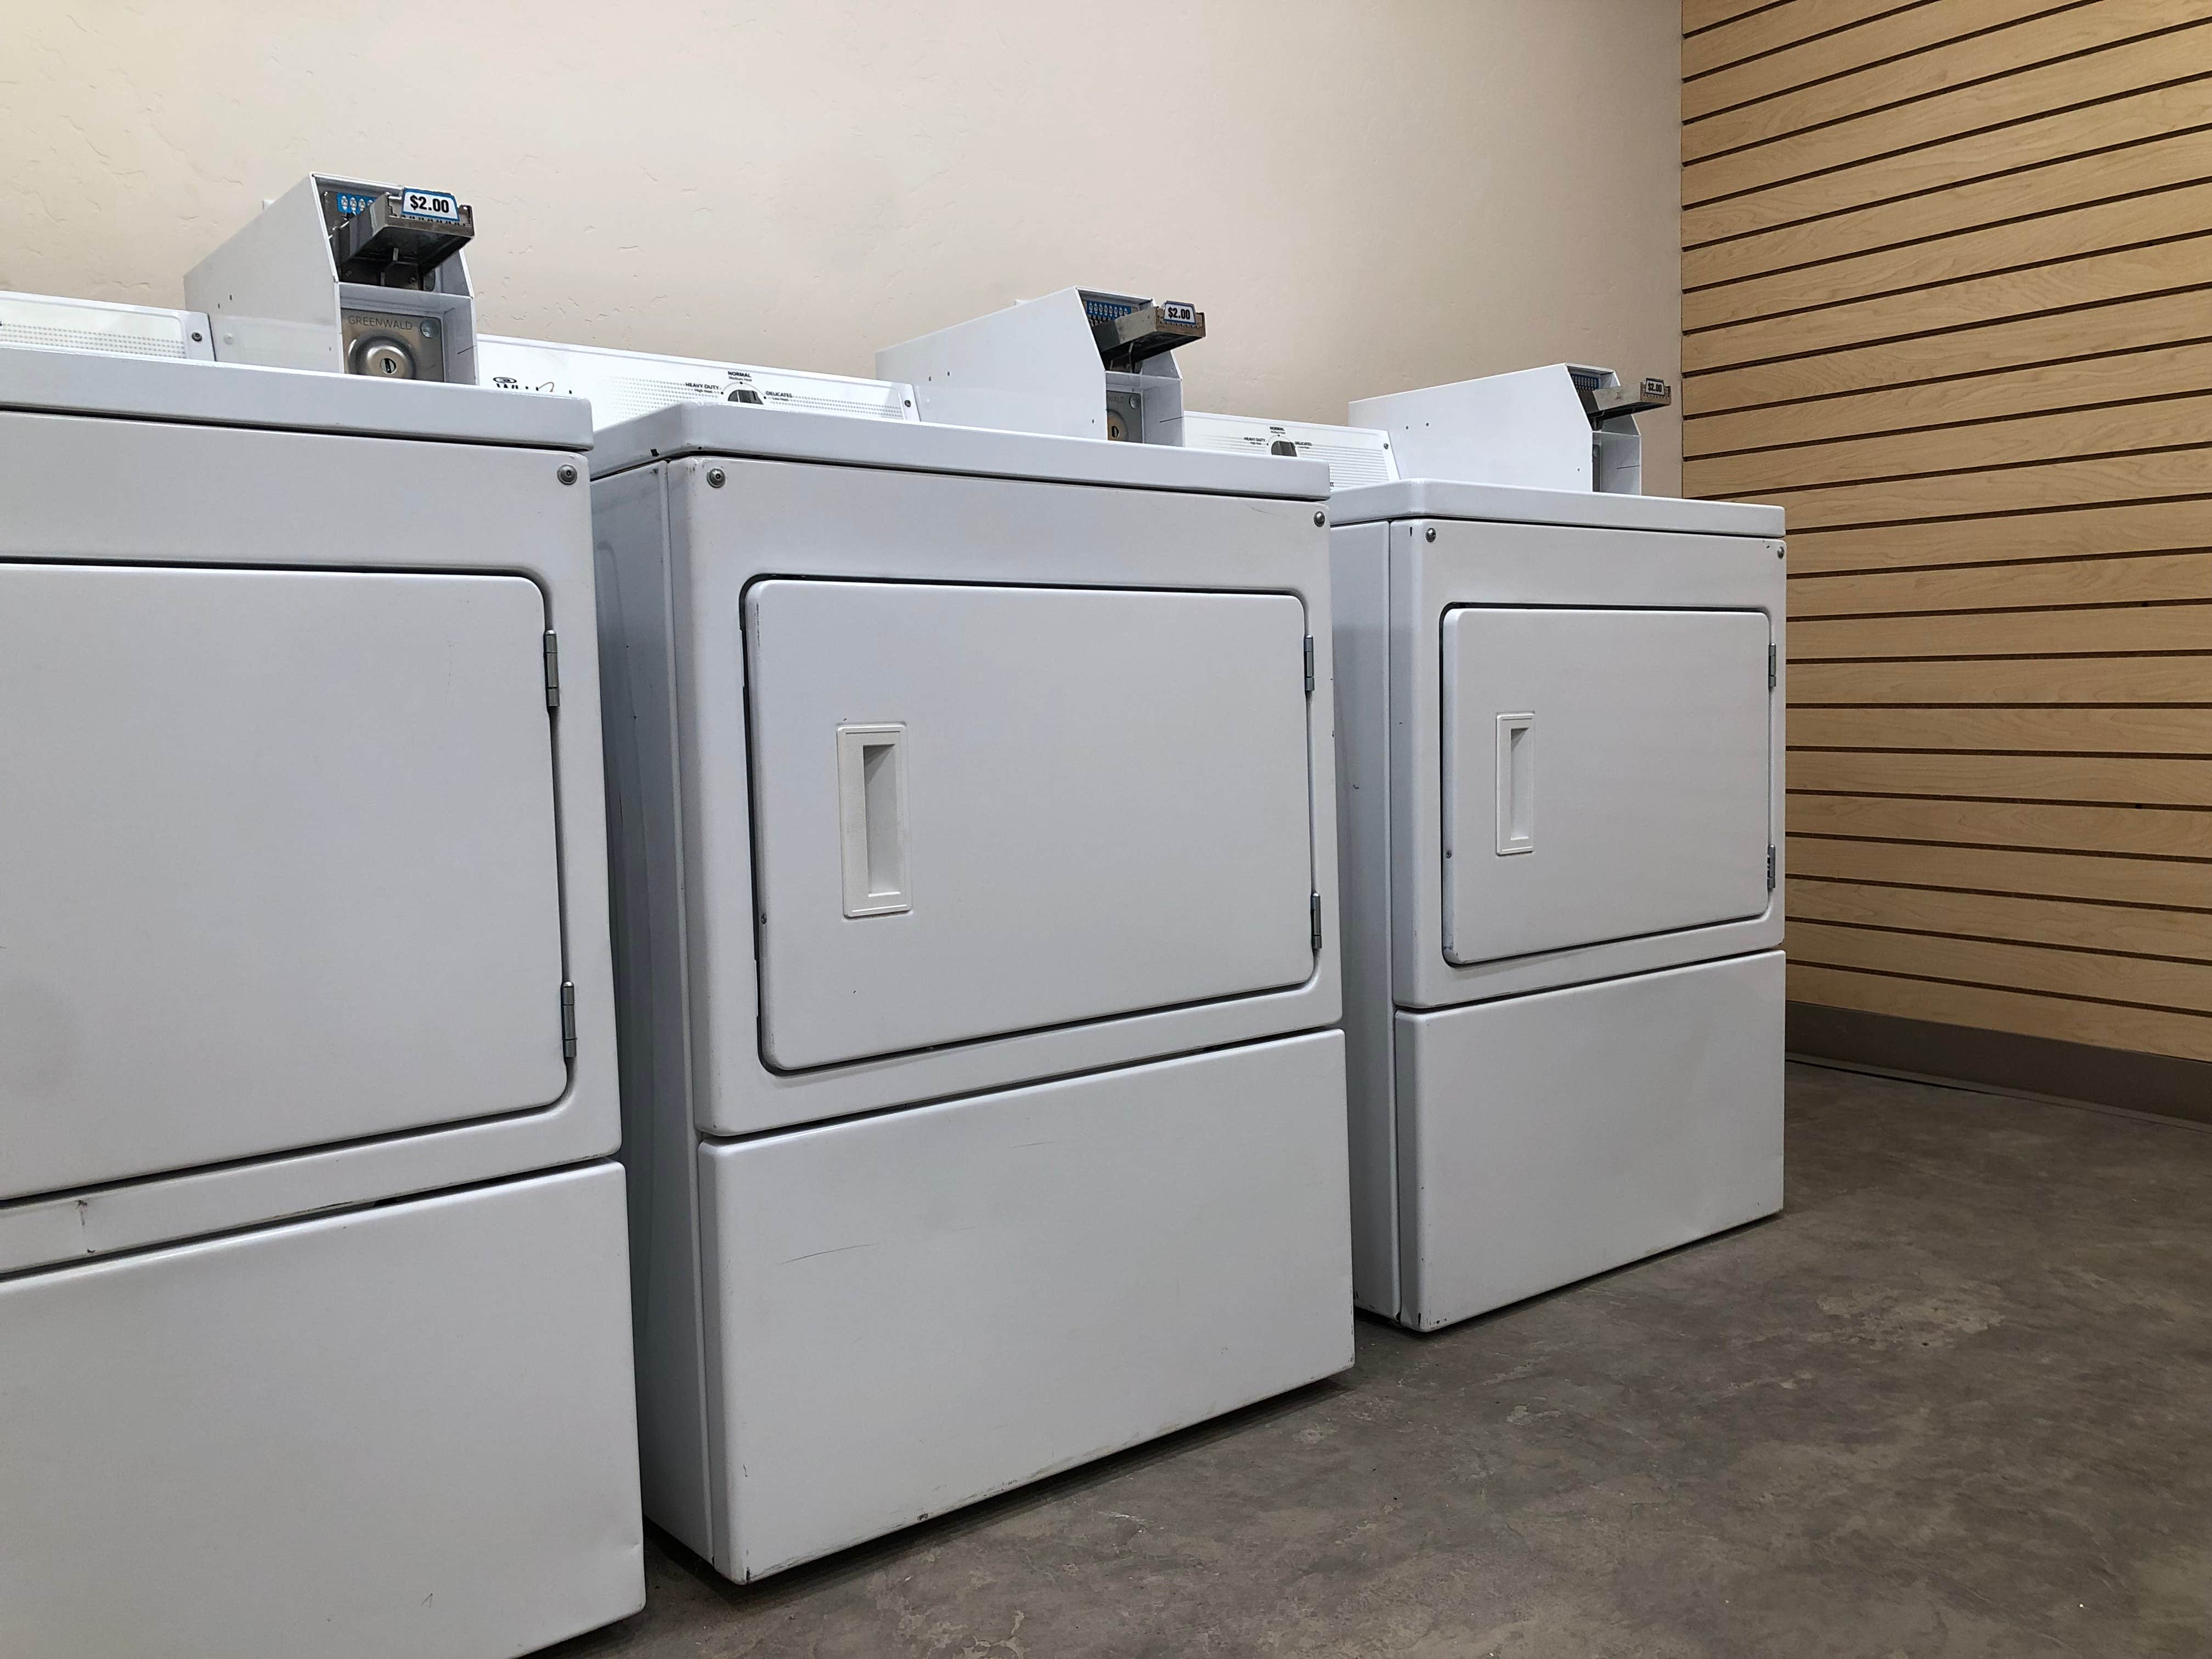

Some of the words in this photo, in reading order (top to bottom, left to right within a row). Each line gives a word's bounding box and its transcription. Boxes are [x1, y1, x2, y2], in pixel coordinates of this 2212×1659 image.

[410, 195, 449, 213] $2.00
[1168, 307, 1190, 320] $2.00
[348, 315, 413, 330] GREENWALD
[1648, 382, 1662, 393] $2.00
